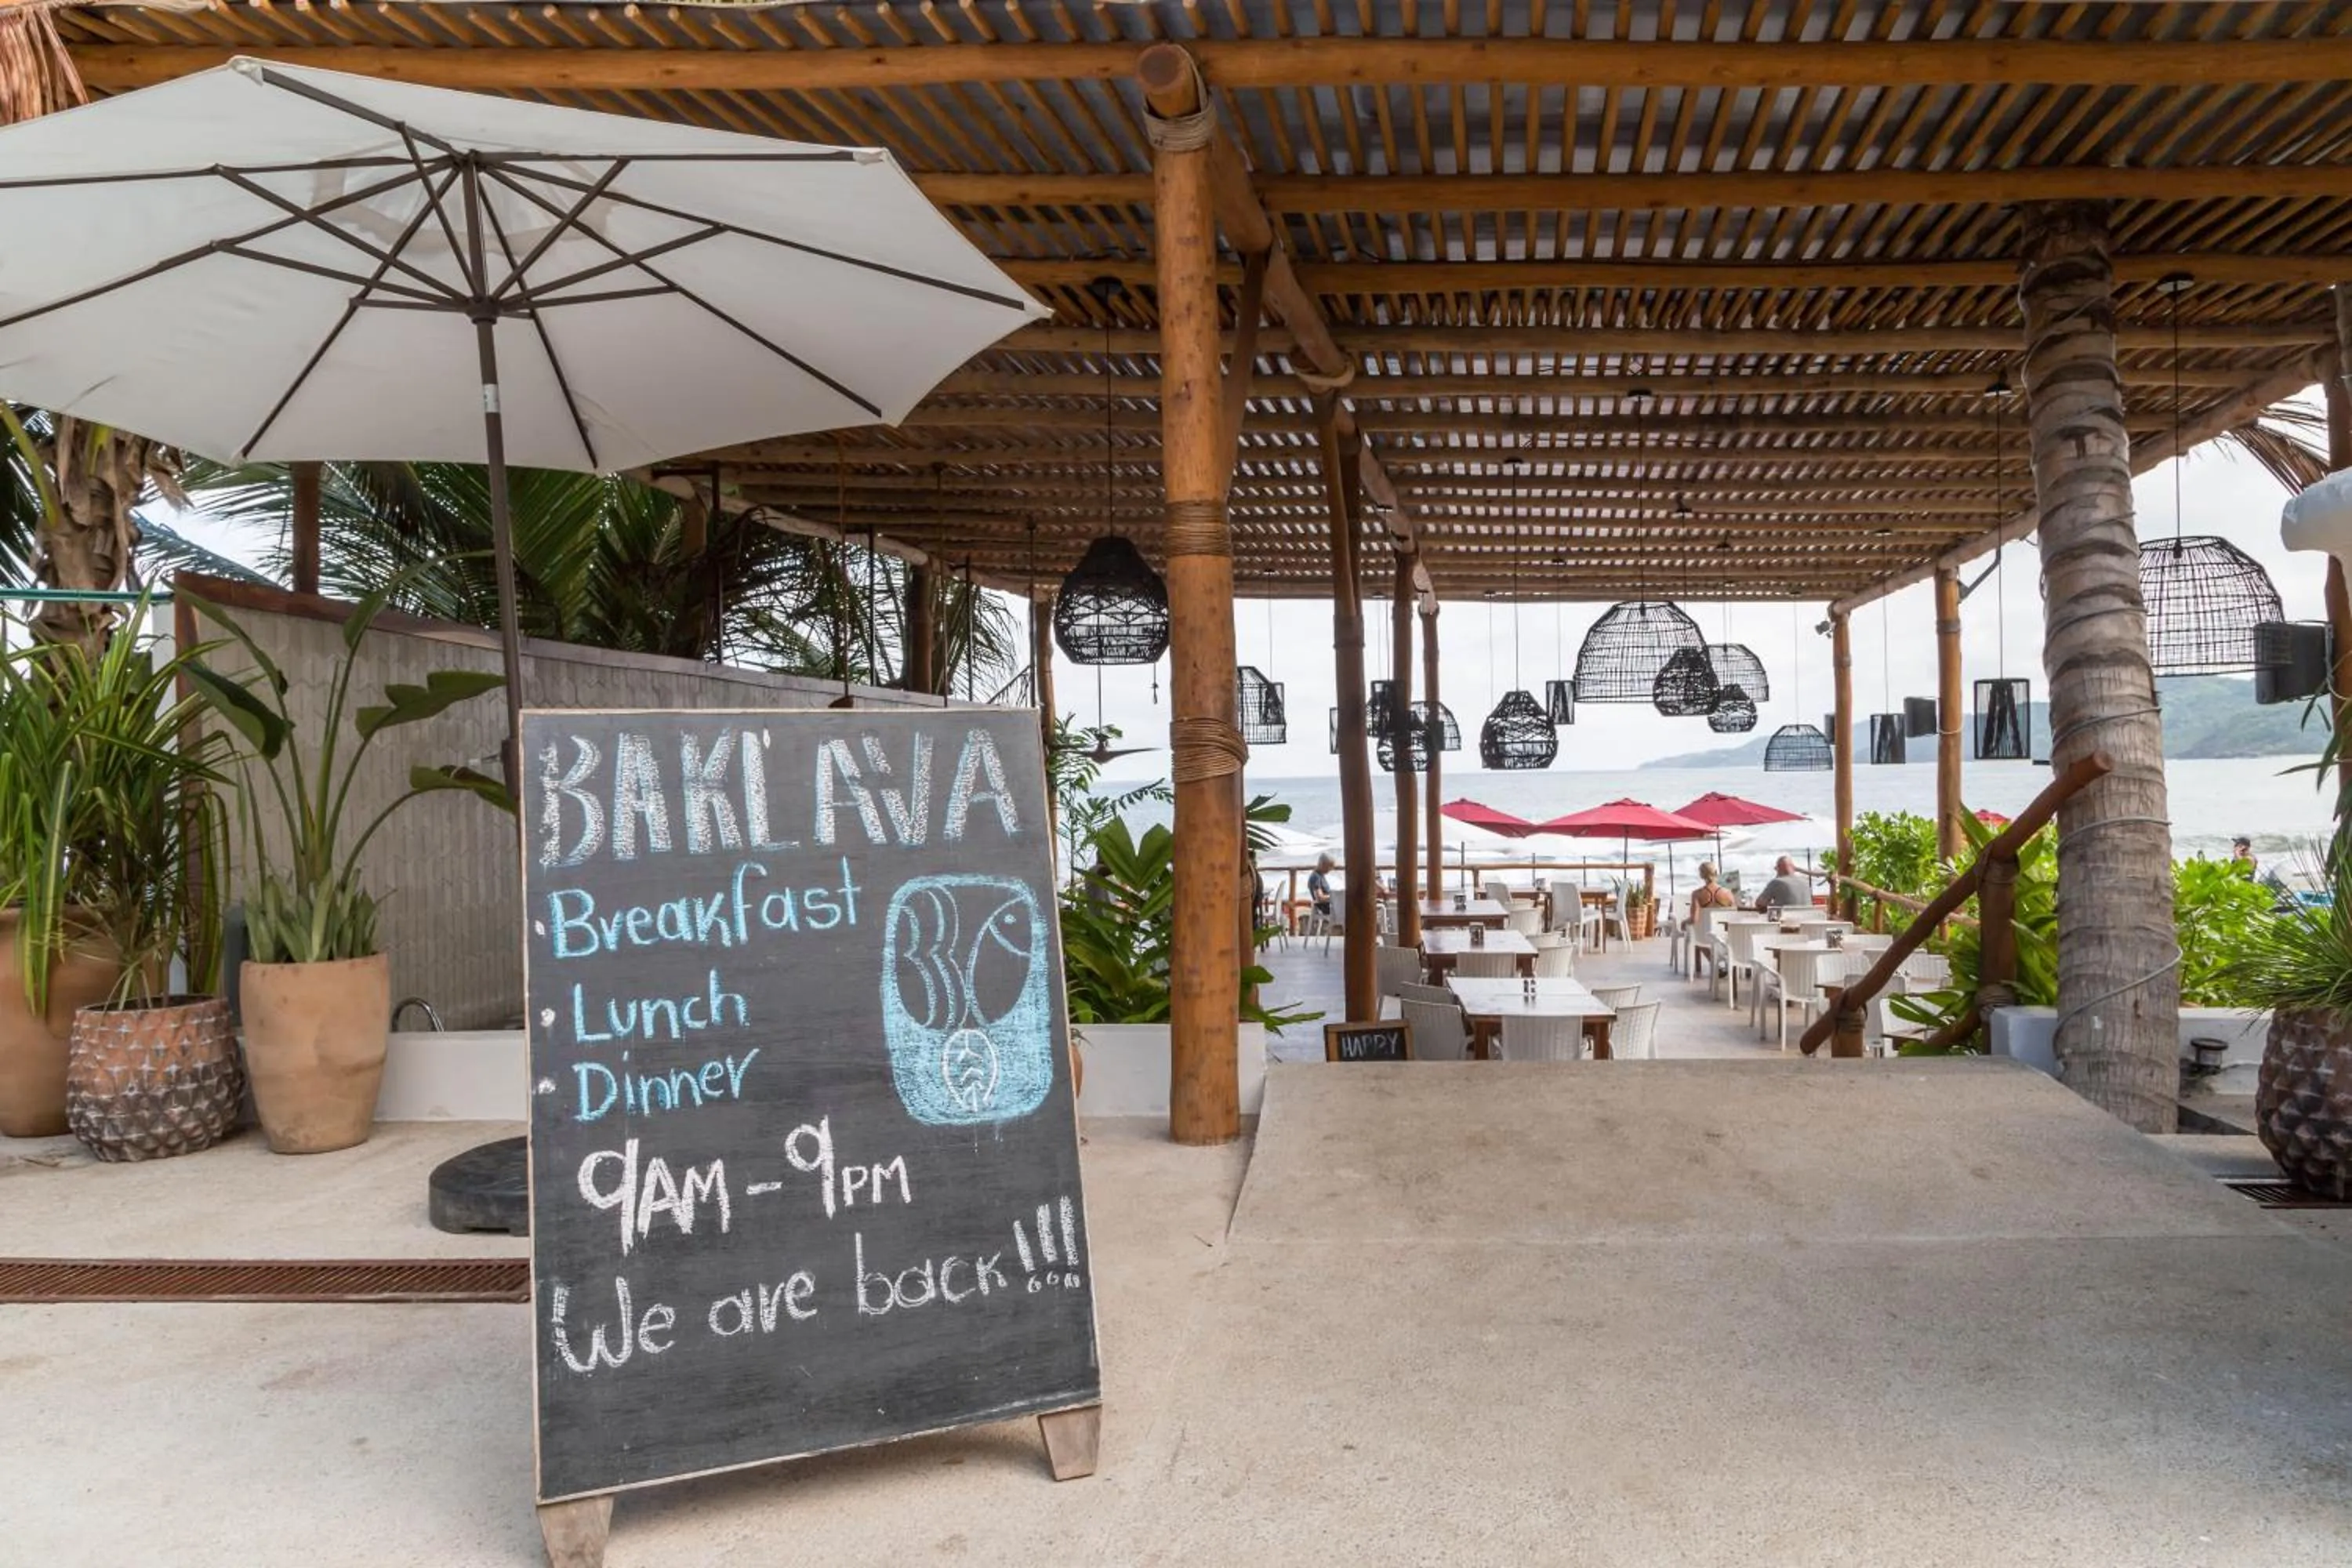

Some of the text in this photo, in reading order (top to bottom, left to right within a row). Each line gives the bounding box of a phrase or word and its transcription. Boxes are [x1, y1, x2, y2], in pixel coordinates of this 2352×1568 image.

[550, 856, 862, 959] Breakfast
[573, 969, 750, 1043] Lunch
[1341, 1032, 1399, 1058] HAPPY
[572, 1048, 760, 1123] Dinner
[552, 1276, 678, 1374] We
[707, 1270, 818, 1337] are
